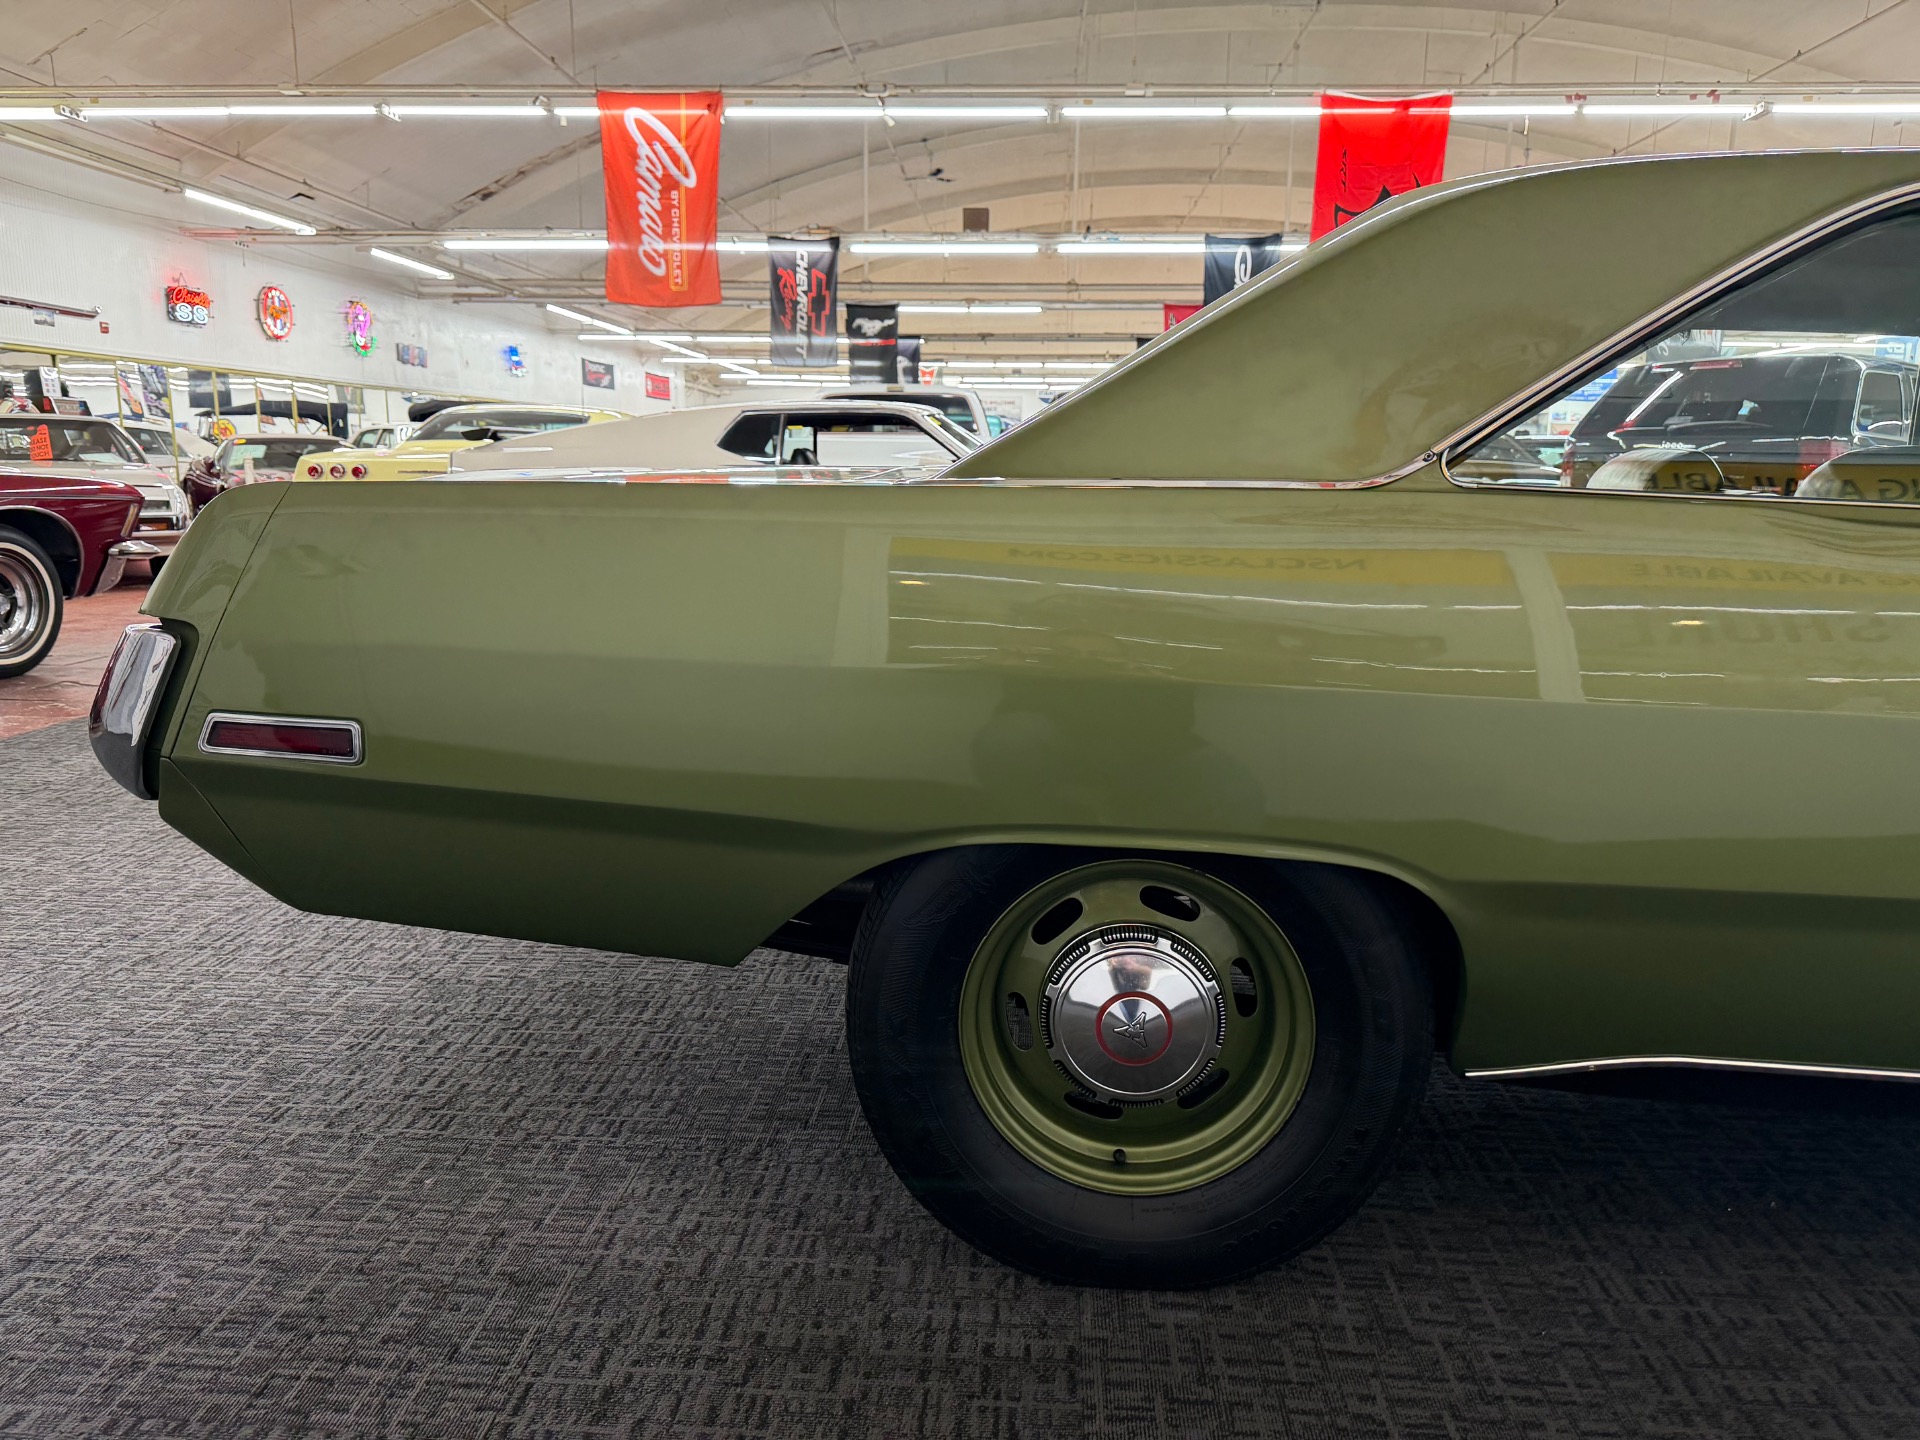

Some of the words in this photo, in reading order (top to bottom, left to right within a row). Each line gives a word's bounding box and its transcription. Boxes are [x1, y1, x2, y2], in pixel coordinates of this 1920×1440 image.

[624, 107, 698, 277] Camaro
[670, 190, 680, 206] BY
[175, 302, 209, 324] SS
[796, 249, 809, 360] CHEVROLET
[31, 451, 50, 459] OUCH
